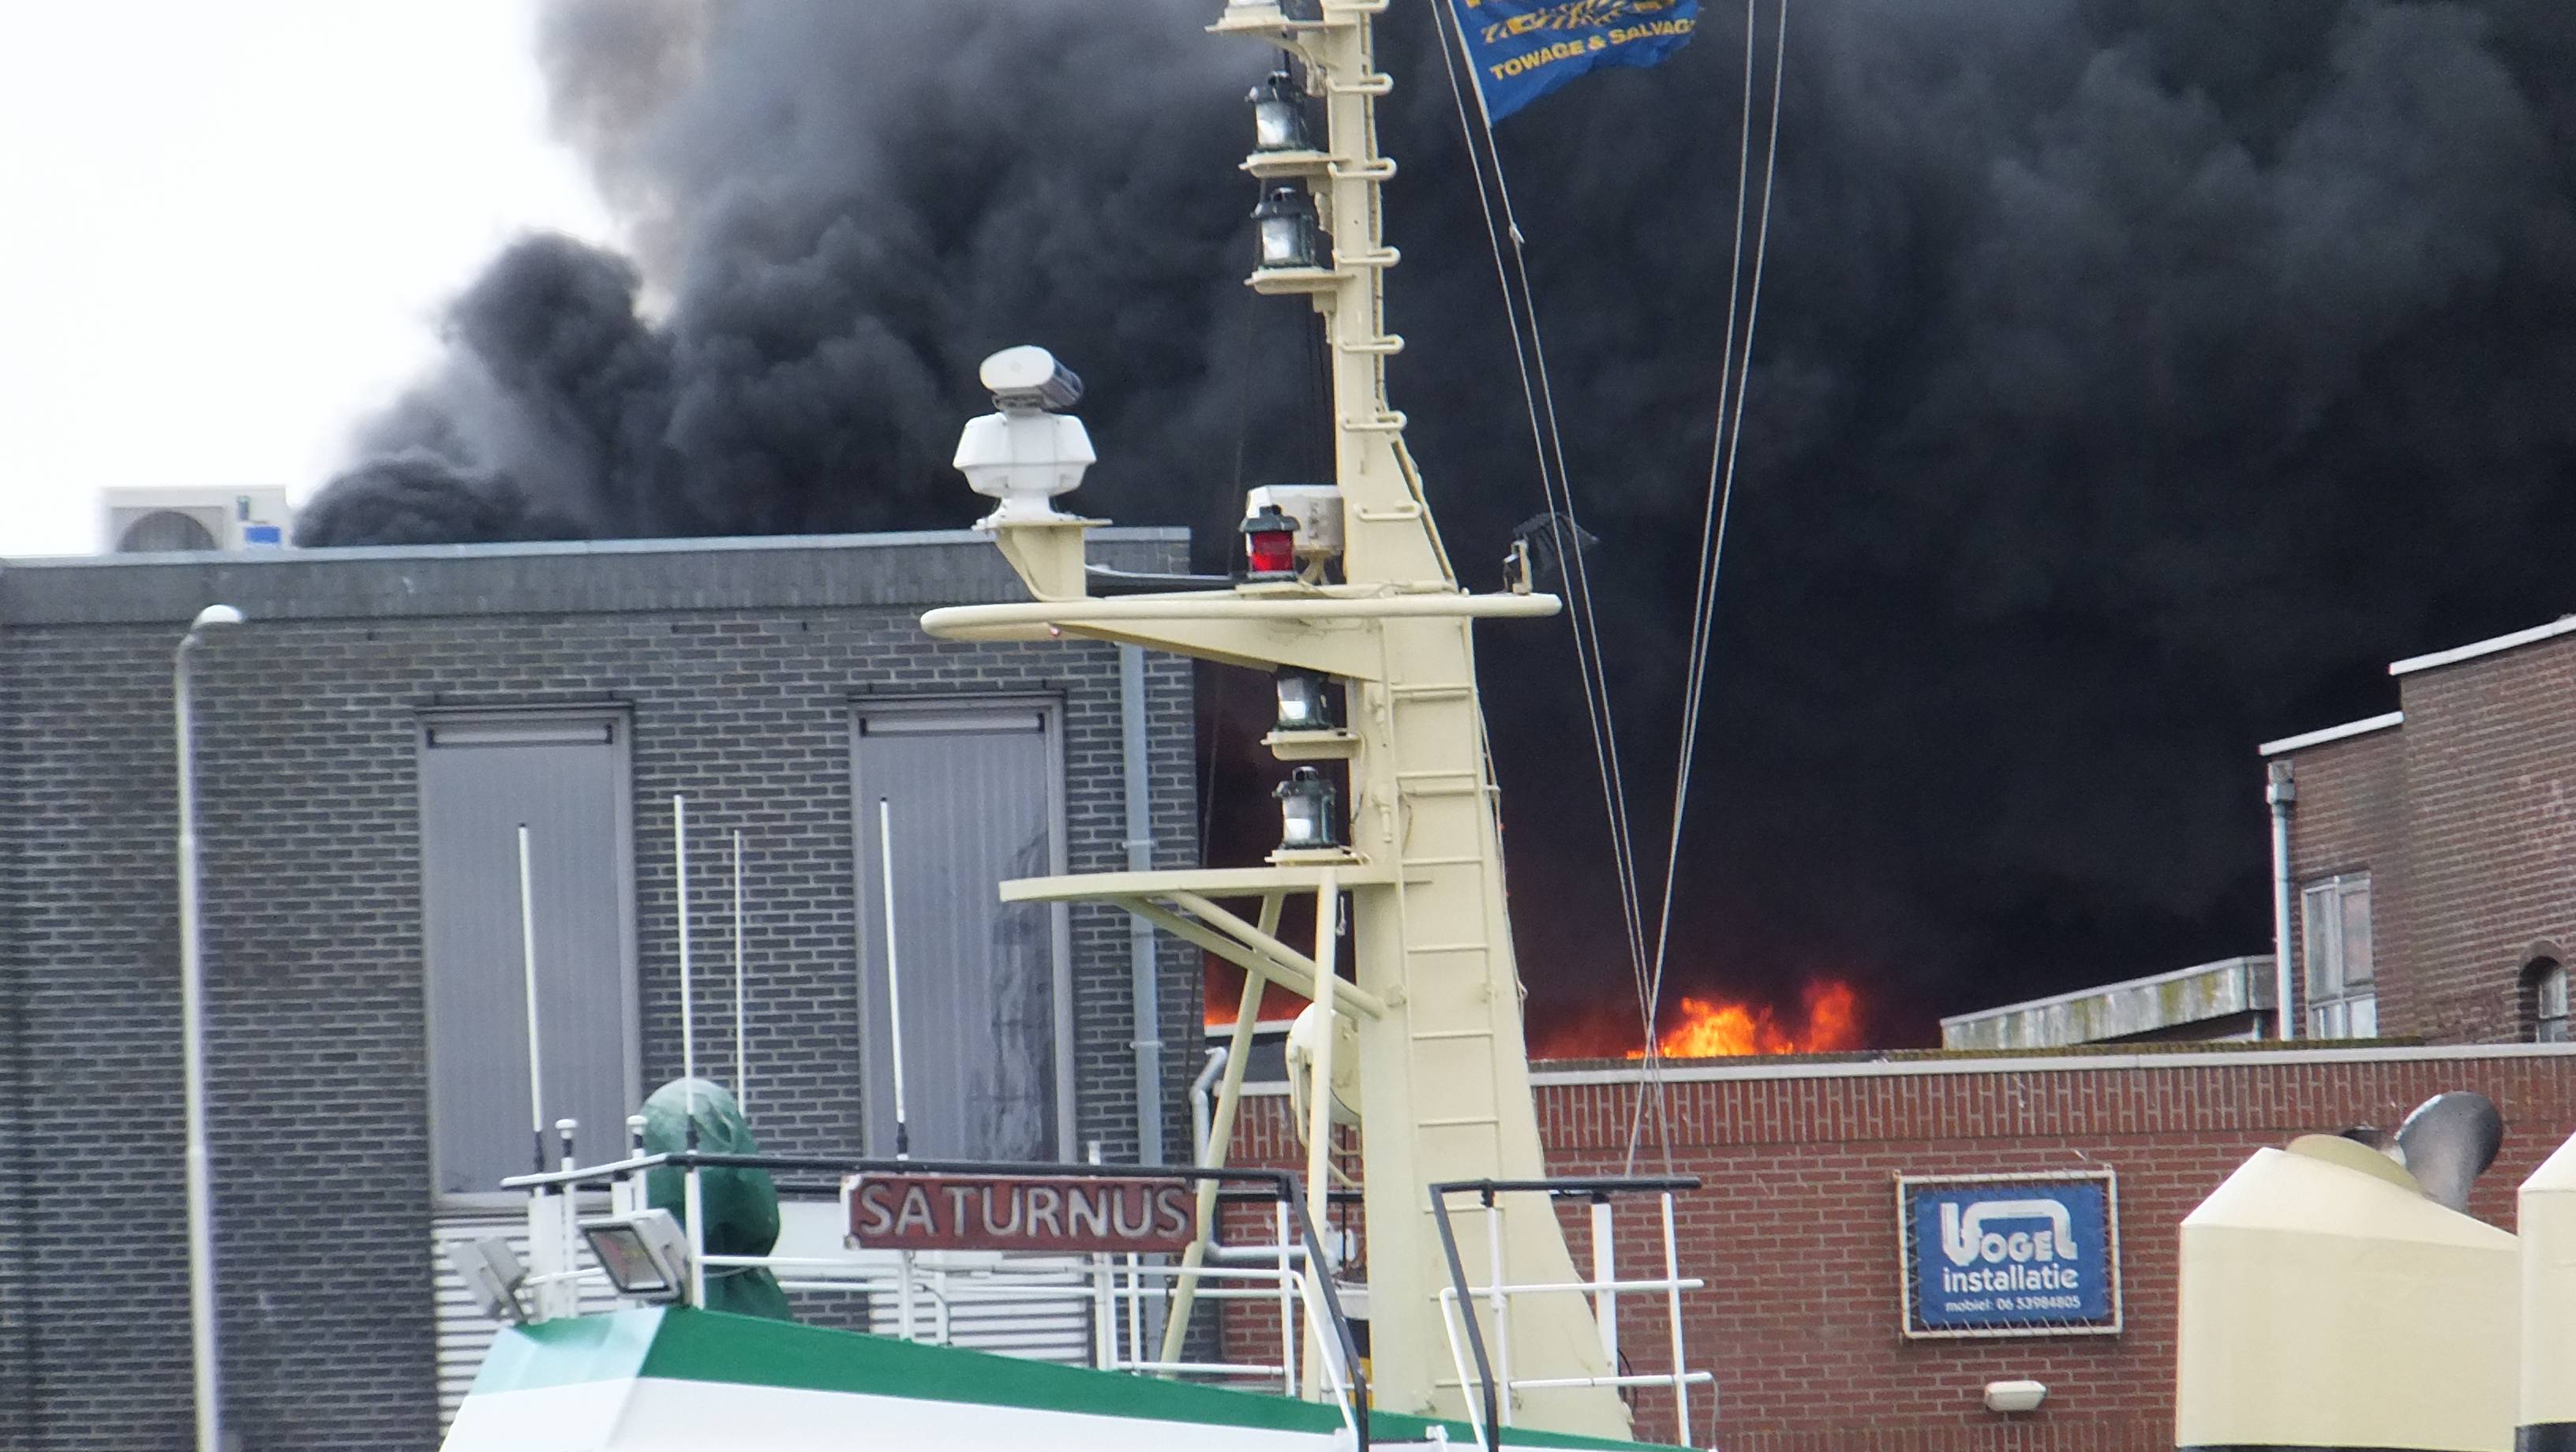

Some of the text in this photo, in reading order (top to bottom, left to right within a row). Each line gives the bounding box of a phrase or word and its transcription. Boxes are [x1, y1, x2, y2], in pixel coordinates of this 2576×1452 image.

[1489, 19, 1696, 80] TOWAGE & SALVAG
[862, 1184, 1187, 1241] SATURNUS
[1941, 1199, 2078, 1267] VOGEL
[1943, 1263, 2079, 1293] installatie
[1945, 1298, 1994, 1312] mobiel:
[1996, 1297, 2012, 1311] 06
